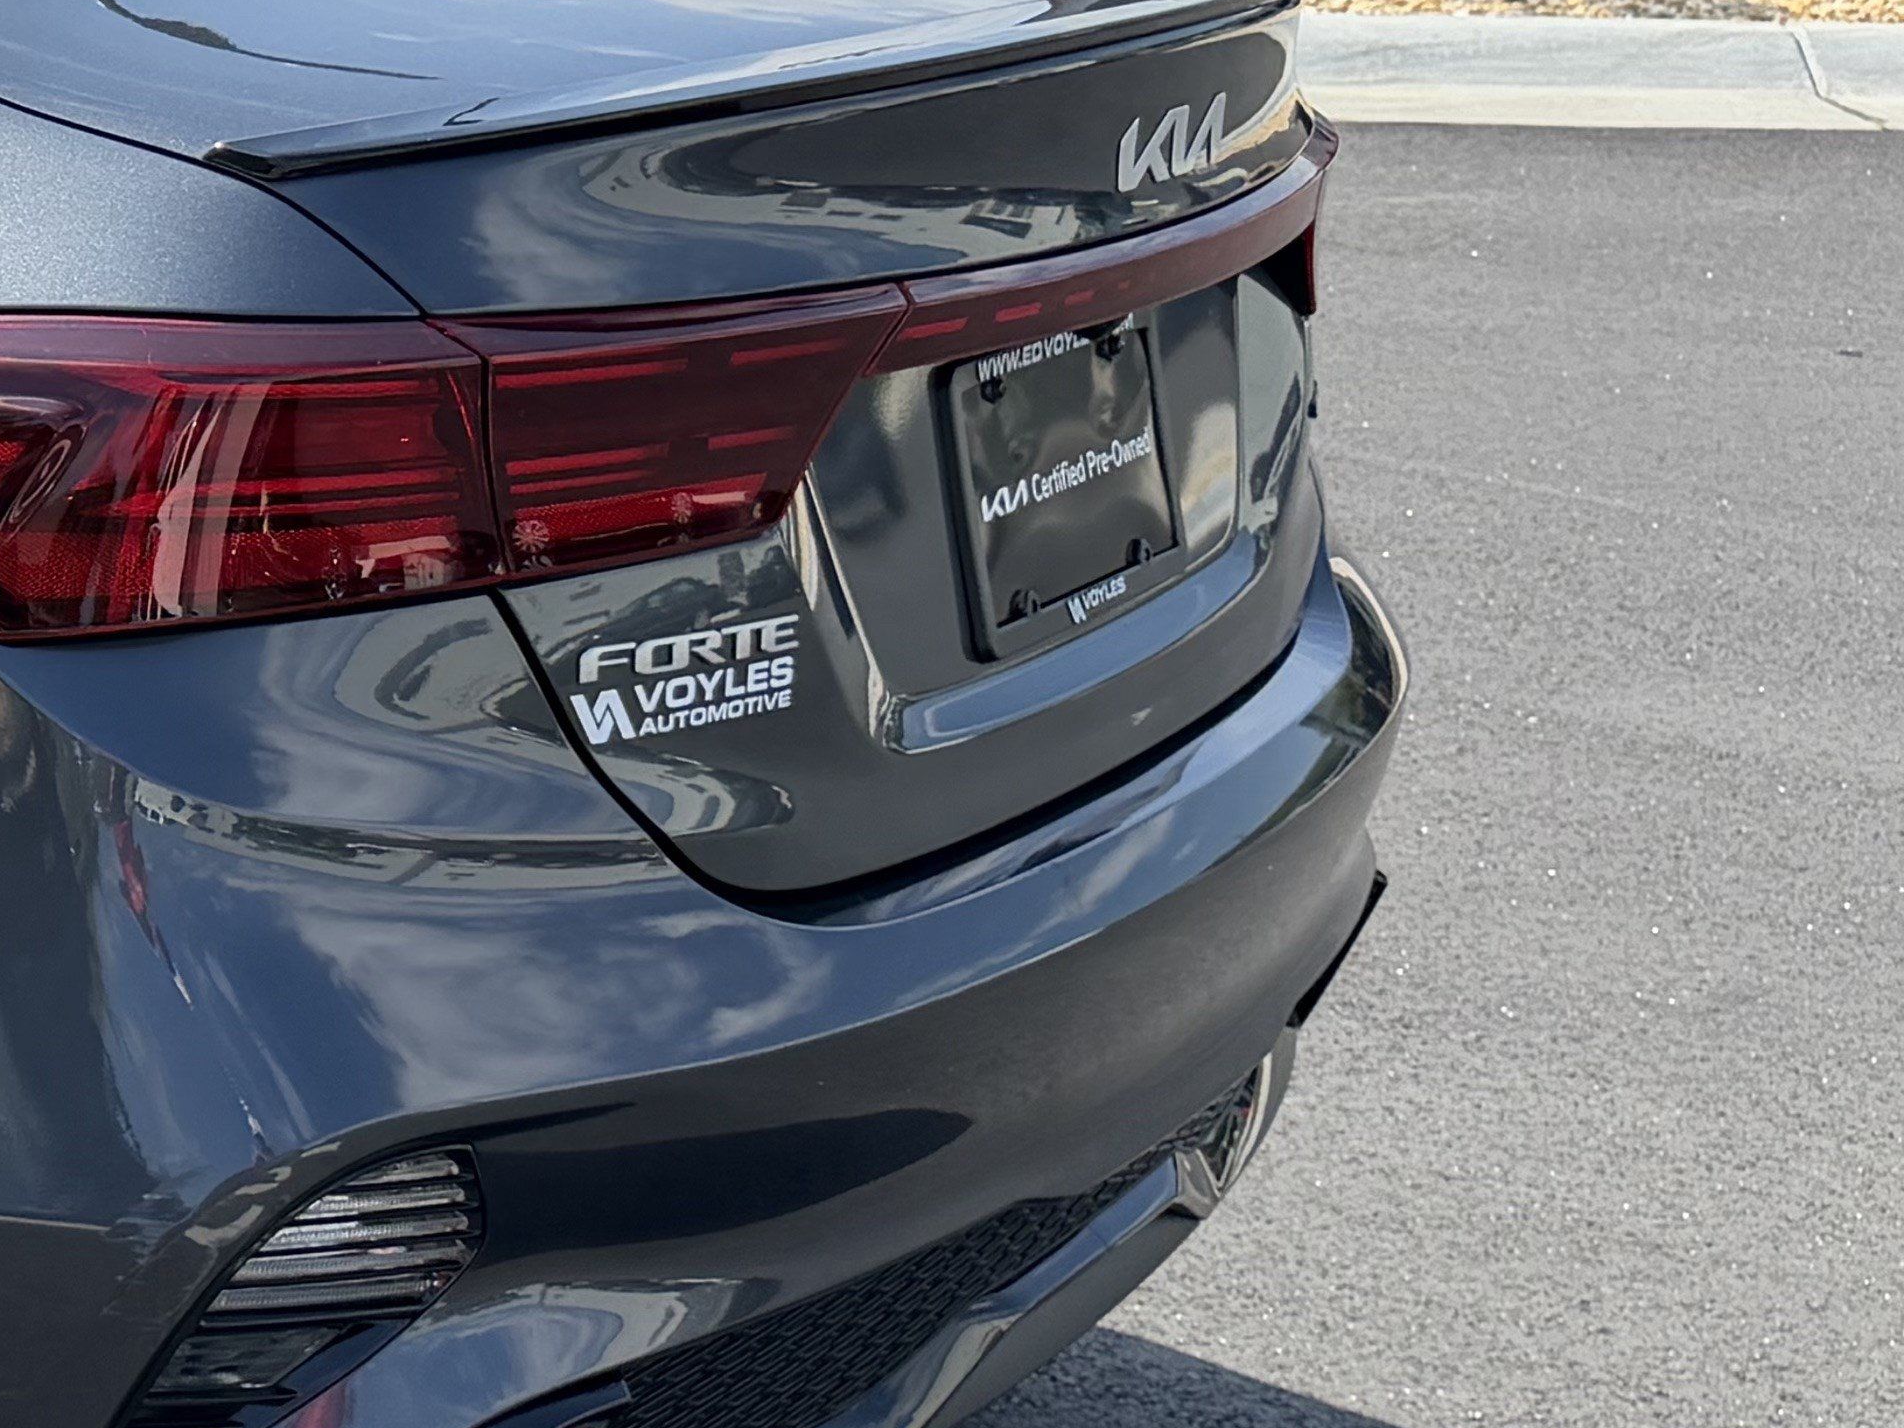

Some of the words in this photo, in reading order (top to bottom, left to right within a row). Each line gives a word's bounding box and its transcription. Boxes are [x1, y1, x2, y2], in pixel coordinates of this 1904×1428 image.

[1031, 454, 1087, 503] Certified
[1086, 426, 1152, 479] Pre-Owned
[1081, 575, 1127, 610] VOYLES
[578, 614, 800, 684] FORTE
[634, 655, 795, 713] VOYLES
[638, 689, 793, 737] AUTOMOTIVE
